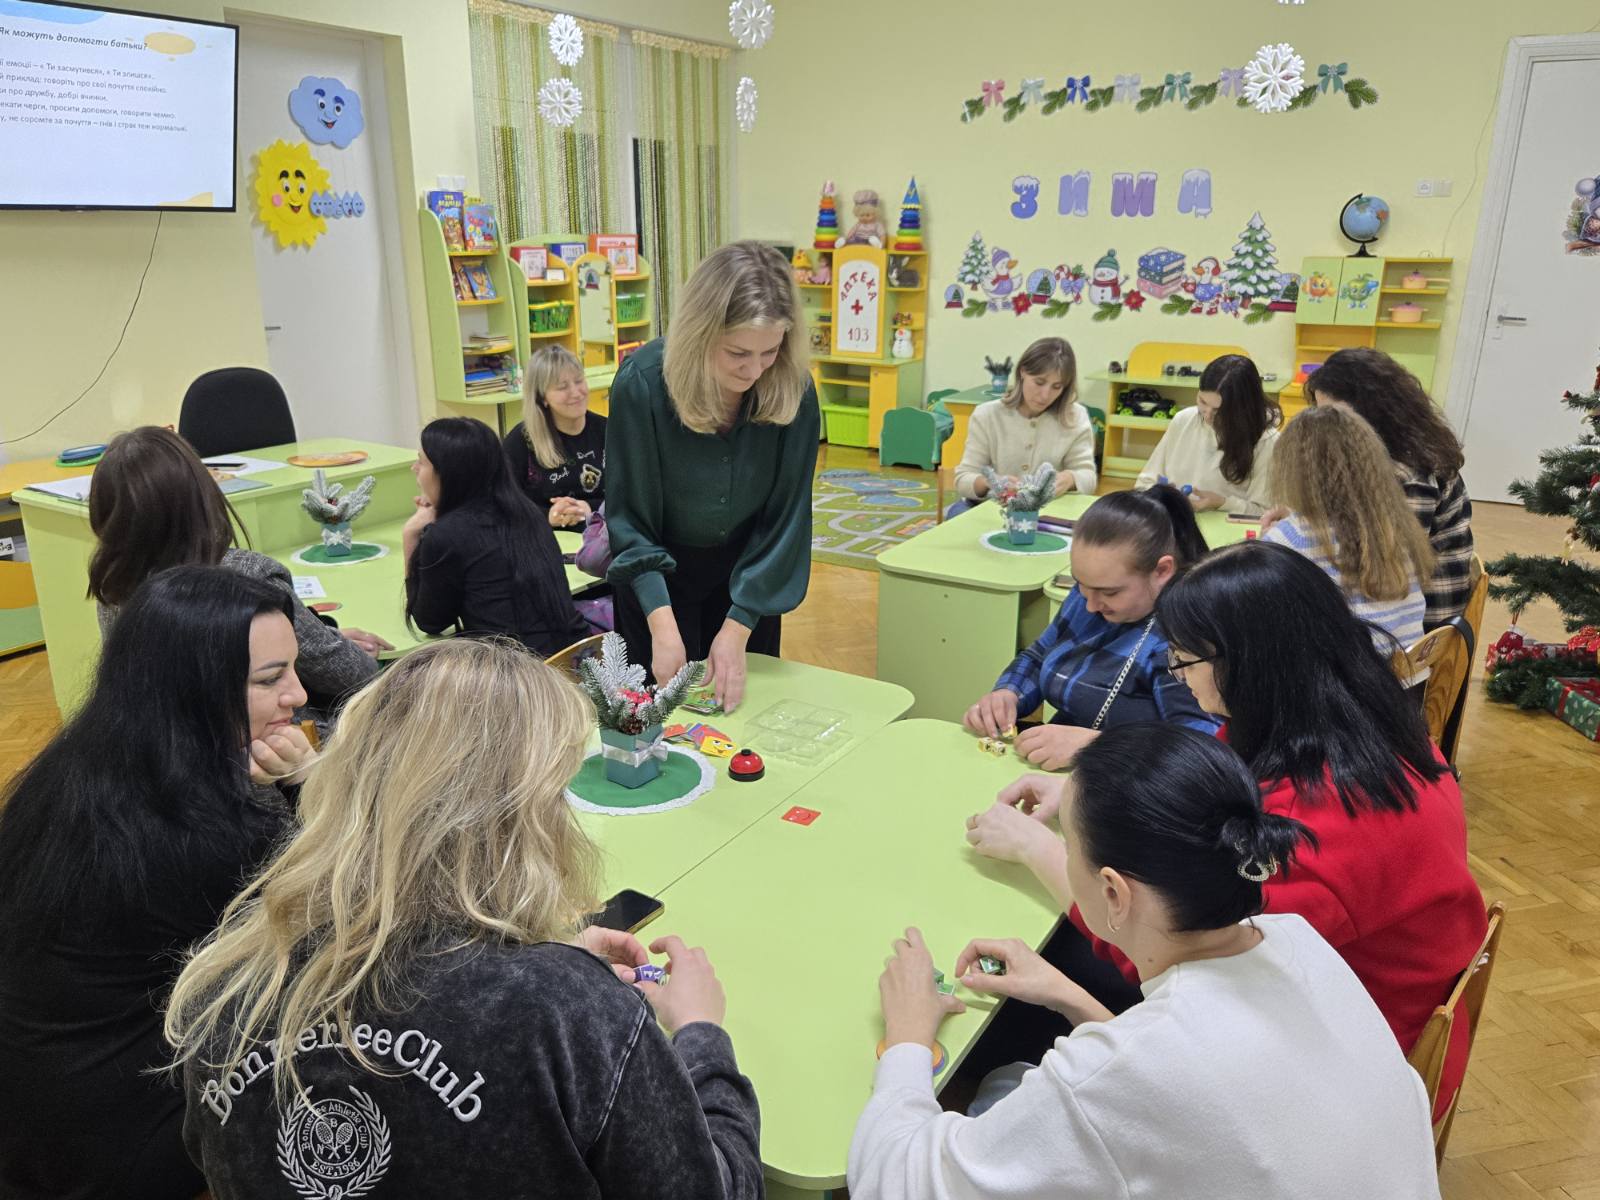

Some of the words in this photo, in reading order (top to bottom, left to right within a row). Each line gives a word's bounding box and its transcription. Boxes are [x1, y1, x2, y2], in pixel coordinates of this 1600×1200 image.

[12, 29, 54, 41] можуть
[56, 33, 108, 47] допомогти
[110, 39, 149, 51] батьки?
[6, 60, 32, 69] емоції
[46, 62, 55, 71] Ти
[112, 69, 122, 77] Ти
[6, 74, 42, 84] приклад:
[44, 77, 75, 87] говоріть
[77, 80, 91, 88] про
[92, 81, 107, 89] свої
[108, 83, 135, 93] почуття
[9, 88, 24, 97] про
[25, 89, 56, 100] дружбу,
[57, 91, 79, 100] добрі
[50, 104, 80, 113] просити
[120, 109, 152, 118] говорити
[64, 118, 92, 128] почуття
[1010, 168, 1213, 219] ЗИМА
[840, 271, 878, 302] АПТЕКА
[847, 327, 870, 342] 103
[301, 1104, 327, 1152] Bonneree
[328, 1101, 361, 1124] Athletic
[358, 1125, 369, 1149] Club
